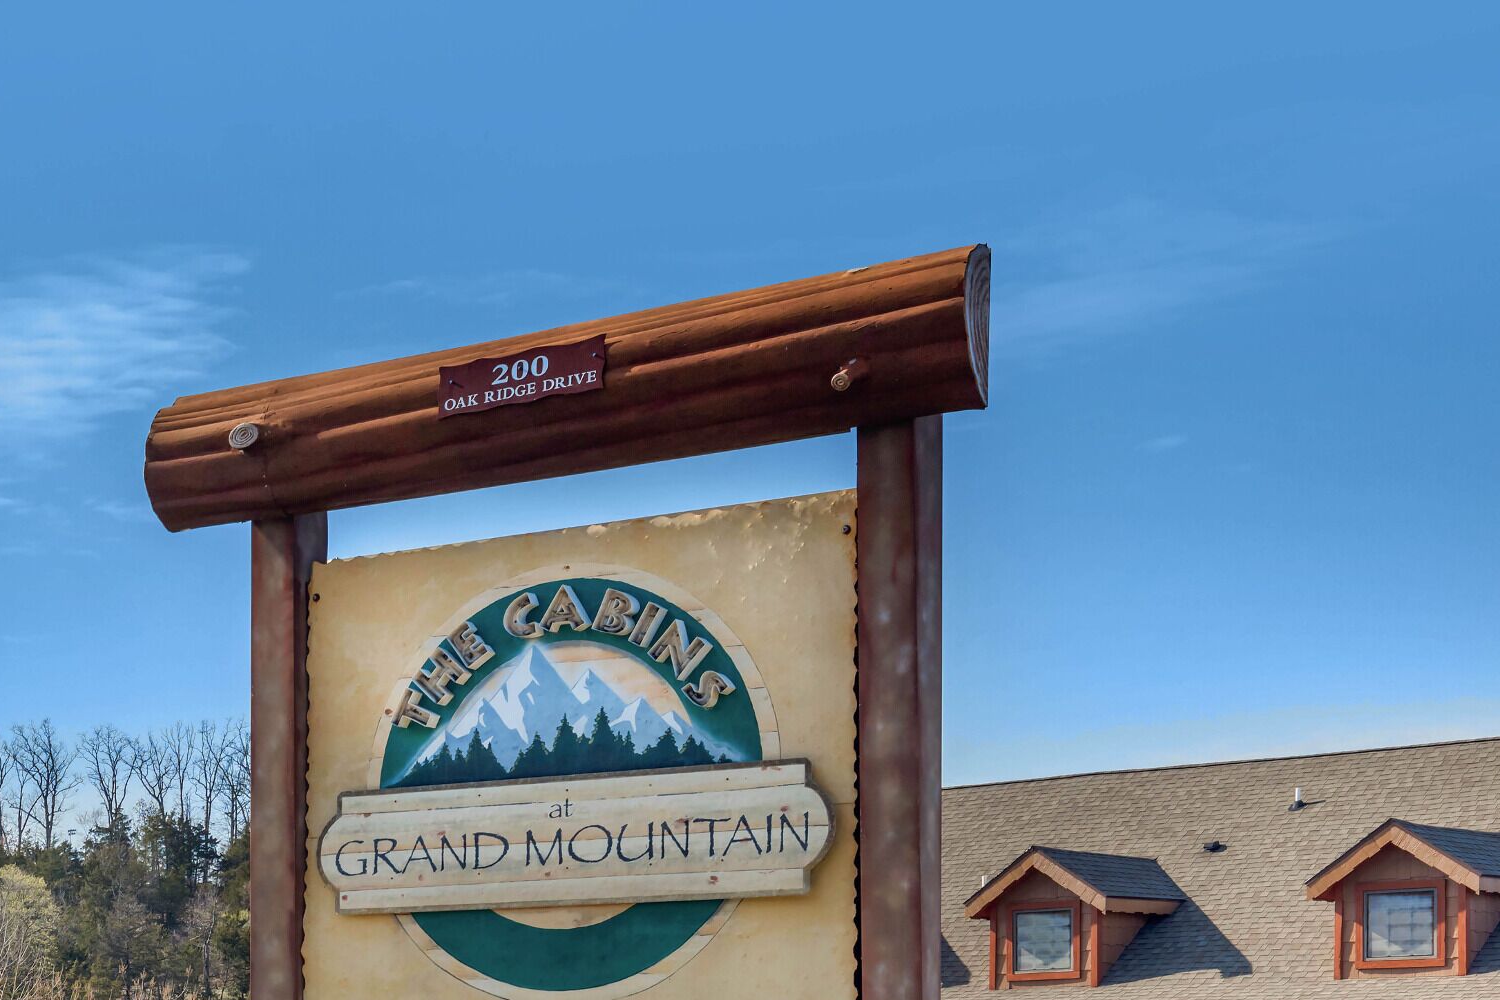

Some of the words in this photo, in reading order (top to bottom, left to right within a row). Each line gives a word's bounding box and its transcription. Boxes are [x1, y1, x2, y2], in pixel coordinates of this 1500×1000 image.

[444, 394, 479, 411] OAK
[484, 382, 537, 404] RIDGE
[542, 370, 597, 392] DRIVE
[491, 355, 549, 386] 200
[392, 621, 495, 728] THE
[503, 584, 736, 709] CABINS
[549, 799, 573, 819] at
[335, 832, 509, 876] GRAND
[525, 812, 810, 866] MOUNTAIN
